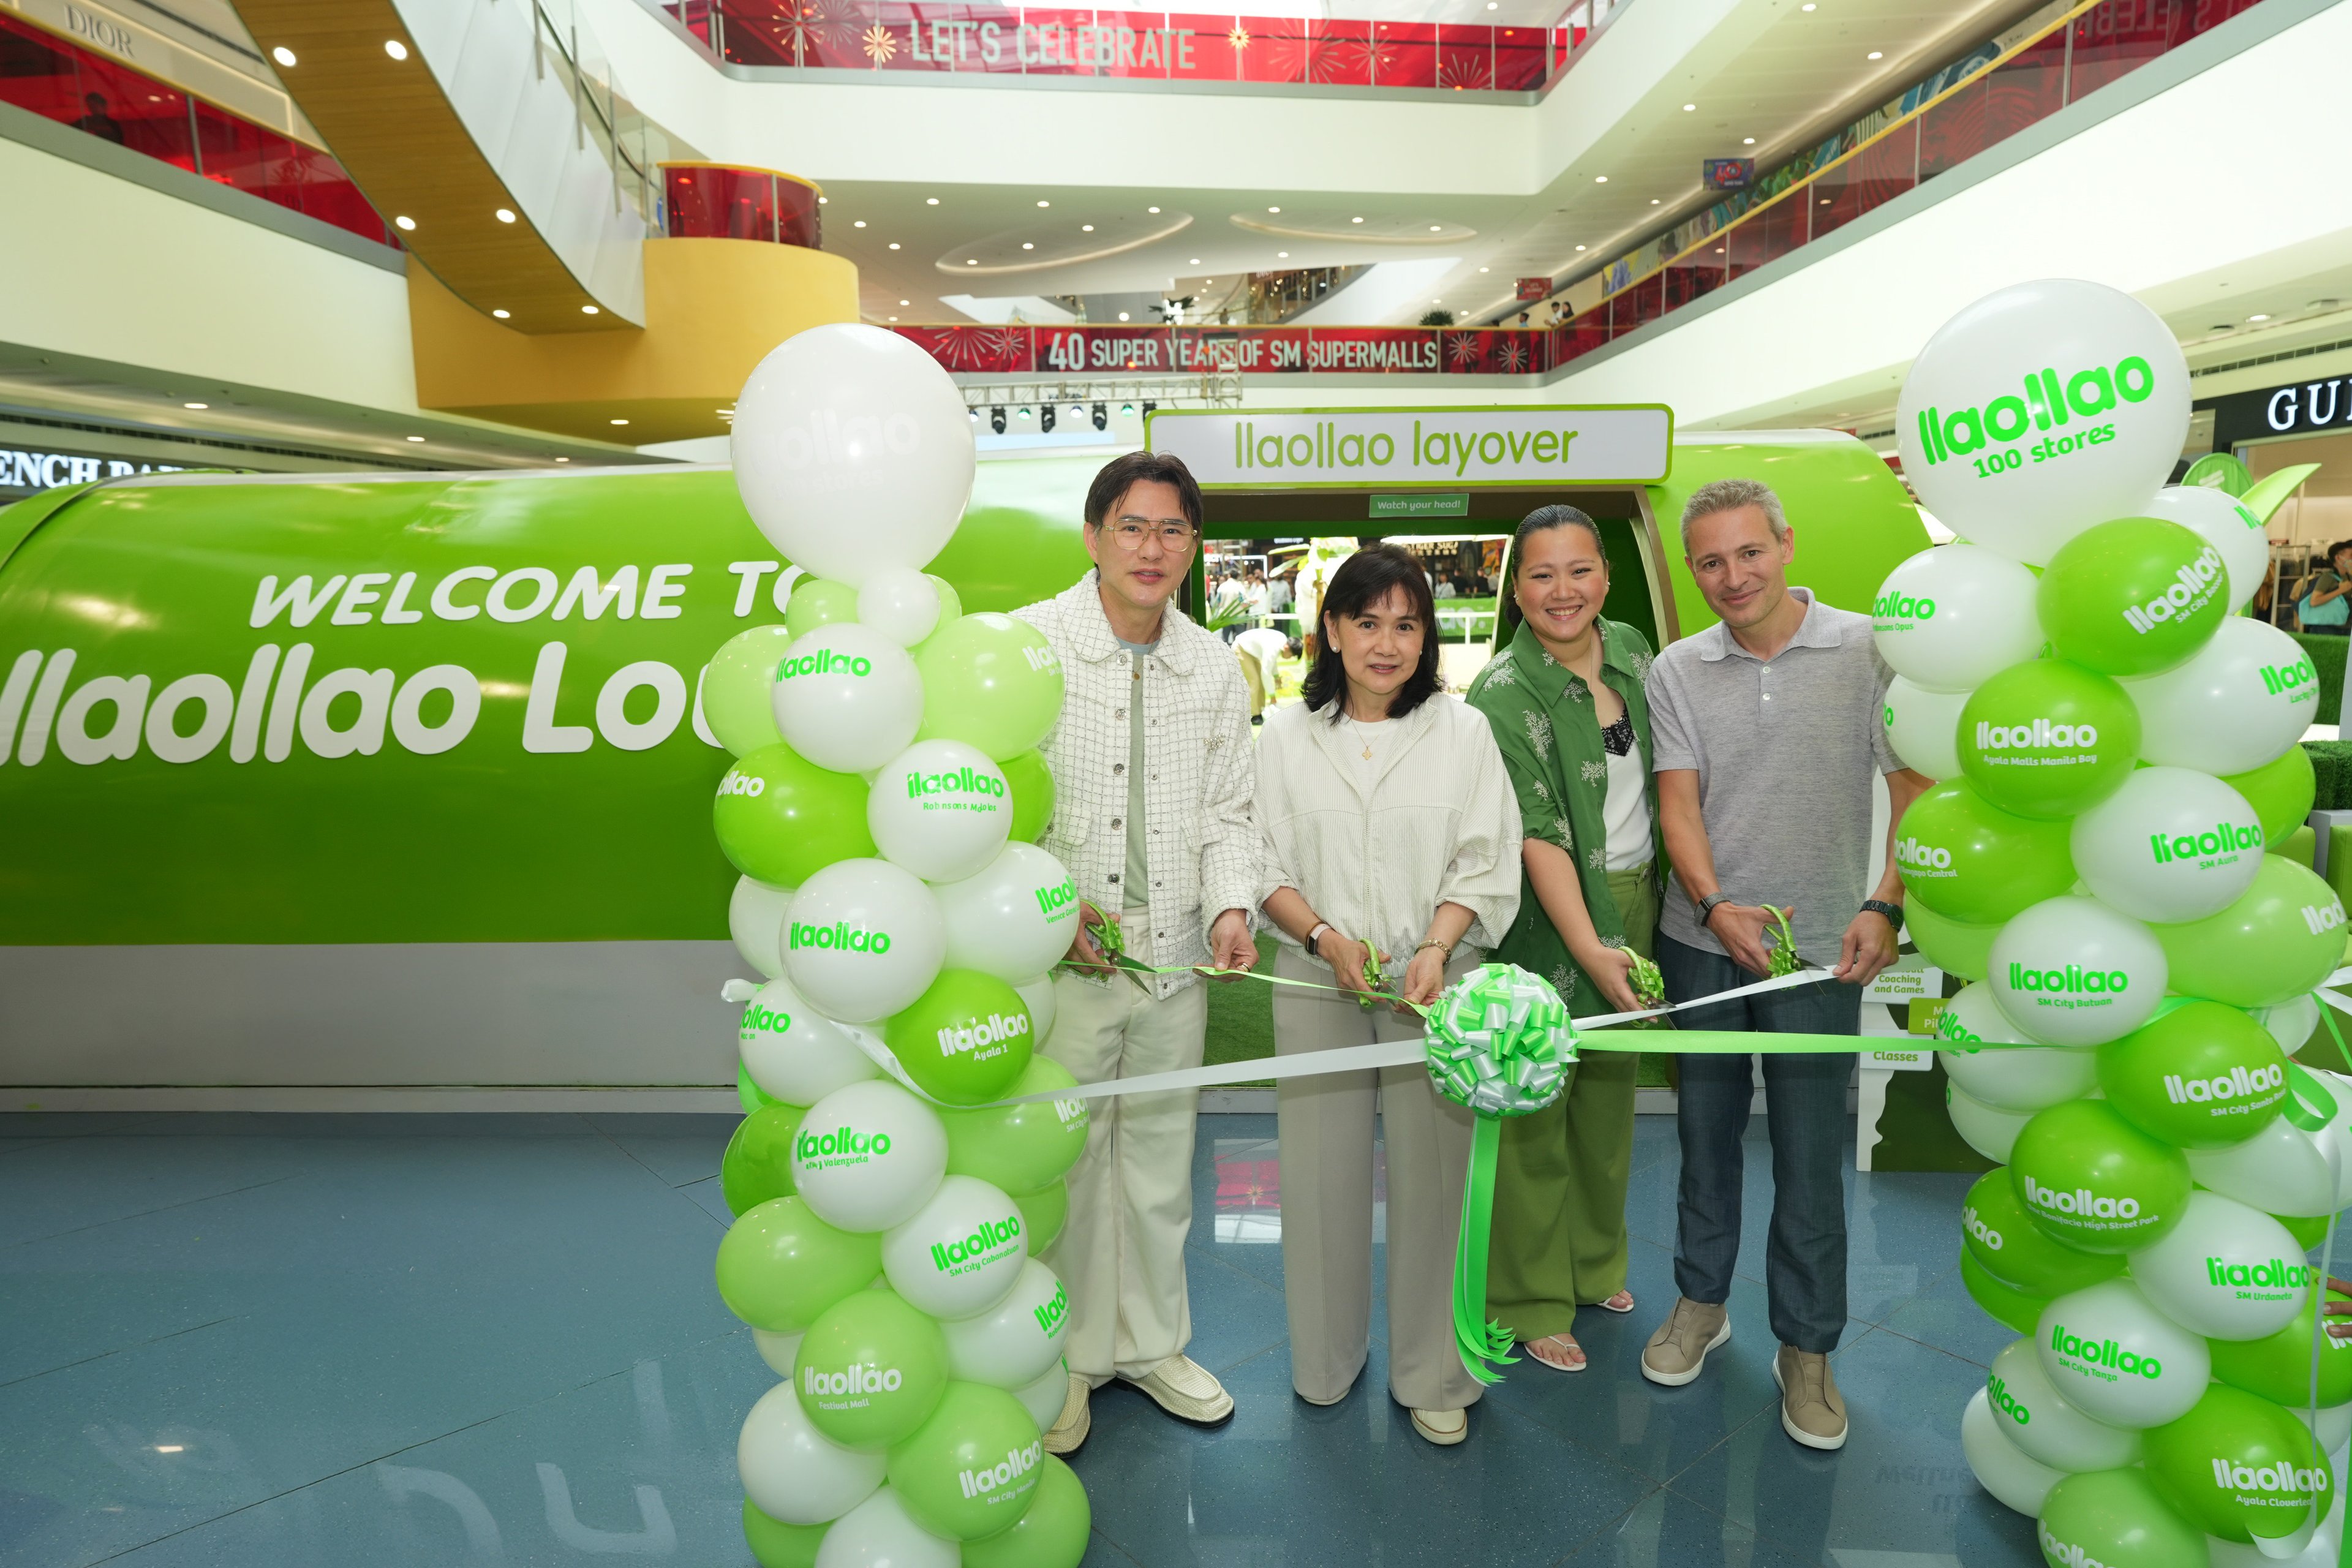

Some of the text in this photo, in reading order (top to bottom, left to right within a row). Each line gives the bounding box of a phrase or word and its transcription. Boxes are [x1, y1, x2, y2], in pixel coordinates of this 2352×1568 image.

[64, 4, 134, 59] DIOR
[910, 19, 1196, 70] LET'S CELEBRATE
[1049, 332, 1085, 371] 40
[1091, 338, 1159, 368] SUPER
[1239, 339, 1264, 367] OF
[1270, 339, 1302, 367] SM
[1307, 340, 1438, 369] SUPERMALLS
[1918, 356, 2154, 466] llaollao
[2267, 379, 2352, 431] GU
[1235, 420, 1578, 477] llaollao layover
[1972, 423, 2116, 478] 100 stores
[1378, 500, 1460, 511] Watch your head!
[249, 563, 693, 628] WELCOME
[2122, 547, 2222, 635] llaollao
[1895, 623, 1913, 632] Opus
[2175, 609, 2192, 624] SM
[776, 648, 872, 683] llaollao
[0, 641, 725, 767] llaollao Lo
[1977, 718, 2098, 750] llaollao
[1983, 754, 2098, 766] Ayala Malls Manila Bay
[907, 766, 1004, 799] llaollao
[2150, 823, 2262, 864] llaollao
[1927, 869, 1958, 878] Central
[2199, 855, 2238, 870] SM Aura
[1046, 912, 1065, 924] Venice
[790, 921, 891, 954] llaollao
[1879, 974, 1921, 986] Coaching
[1894, 985, 1924, 993] Games
[2009, 962, 2128, 993] llaollao
[740, 1004, 791, 1033] ollao
[2037, 997, 2113, 1009] SM City Butuan
[937, 1012, 1028, 1058] llaollao
[1938, 1009, 1982, 1054] ollao
[973, 1044, 1008, 1061] Ayala 1
[1873, 1051, 1918, 1062] Classes
[2163, 1064, 2283, 1104] llaollao
[2211, 1107, 2228, 1117] SM
[2229, 1105, 2249, 1114] City
[2250, 1097, 2274, 1110] Santa
[824, 1155, 869, 1167] Valenzuela
[2024, 1175, 2140, 1219] llaollao
[2041, 1210, 2082, 1227] Bonifacio
[2084, 1219, 2108, 1231] High
[2109, 1219, 2138, 1230] Street
[2139, 1215, 2159, 1226] Park
[930, 1215, 1020, 1272] llaollao
[949, 1244, 1020, 1277] SM City Cabanatuan
[2206, 1257, 2309, 1288] llaollao
[2236, 1291, 2293, 1301] SM Urdaneta
[2052, 1325, 2162, 1379] llaollao
[805, 1363, 902, 1396] llaollao
[2059, 1357, 2117, 1382] SM City Tanza
[818, 1398, 870, 1411] Festival Mall
[1988, 1374, 2030, 1425] ollao
[959, 1440, 1041, 1499] llaollao
[2212, 1458, 2327, 1492] llaollao
[987, 1477, 1036, 1505] SM City Manila
[2236, 1494, 2266, 1506] Ayala
